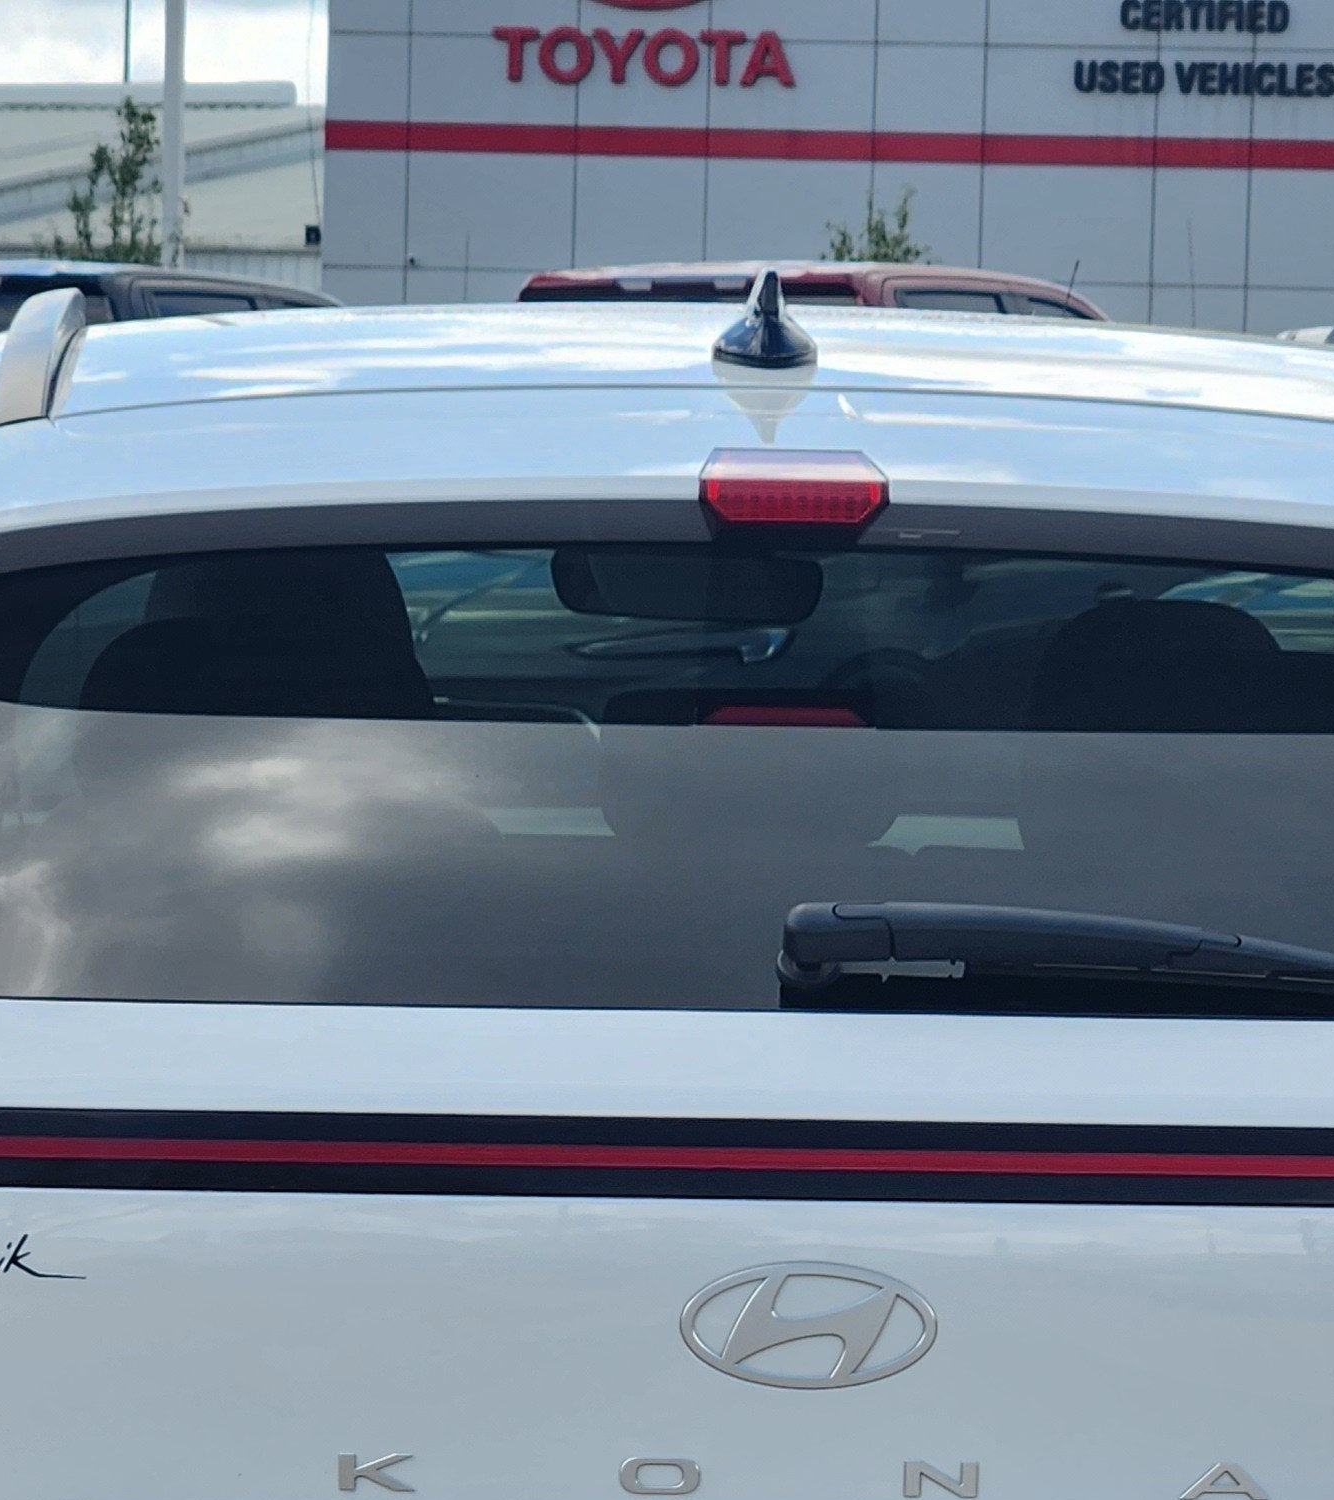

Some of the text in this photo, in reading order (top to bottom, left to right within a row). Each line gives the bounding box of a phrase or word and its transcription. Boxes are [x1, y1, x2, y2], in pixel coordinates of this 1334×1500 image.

[1120, 0, 1290, 33] CERTIFIED
[492, 26, 796, 87] TOYOTA
[1074, 60, 1165, 94] USED
[337, 1451, 1269, 1500] KONA
